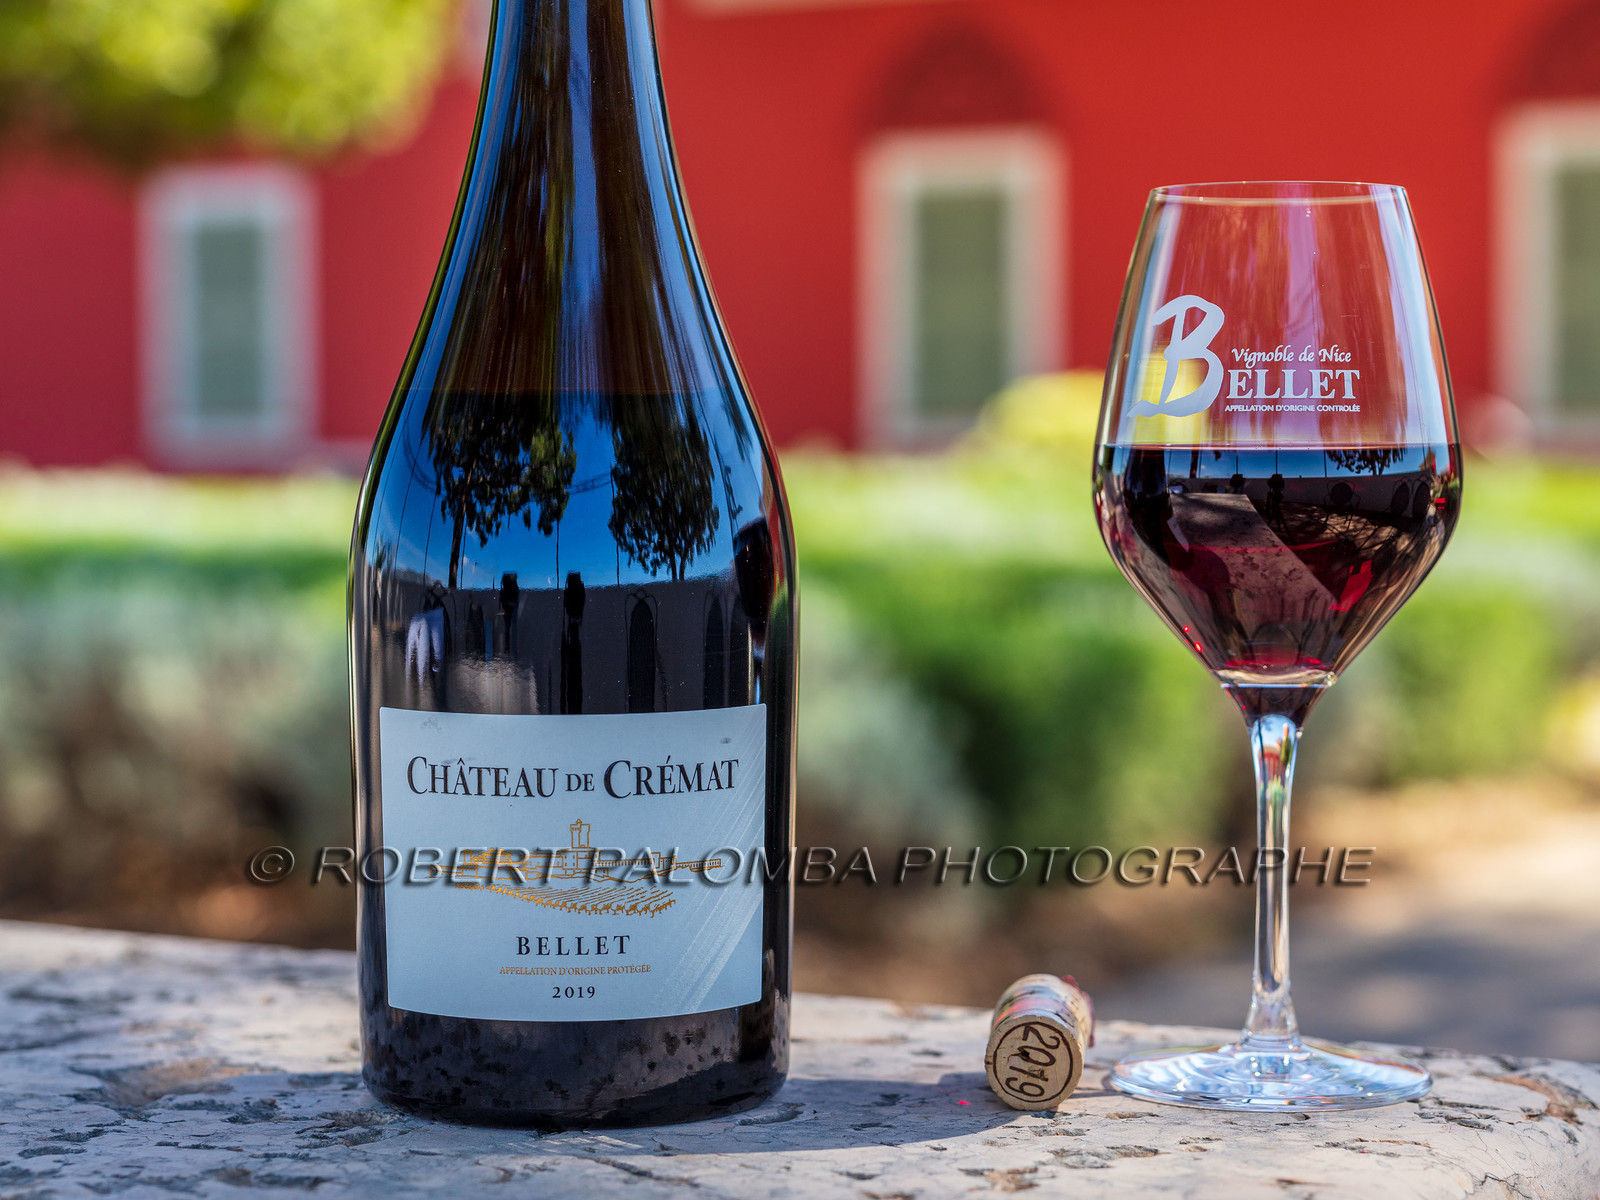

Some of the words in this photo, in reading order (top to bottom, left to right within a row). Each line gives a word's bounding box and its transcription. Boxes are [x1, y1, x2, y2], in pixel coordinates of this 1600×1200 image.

[1231, 345, 1294, 368] Vignoble
[1298, 345, 1314, 362] de
[1318, 344, 1351, 362] Nice
[1224, 404, 1274, 412] APPELLATION
[1275, 404, 1315, 412] D'ORIGINE
[407, 756, 559, 798] CHÂTEAU
[565, 773, 595, 792] DE
[604, 755, 739, 799] CRÉMAT
[516, 935, 630, 956] BELLET
[499, 966, 557, 975] APPELLATION
[558, 966, 605, 975] D'ORIGINE
[607, 963, 651, 975] PROTÉGÉE
[552, 986, 596, 999] 2019
[1005, 1025, 1061, 1097] 2019
